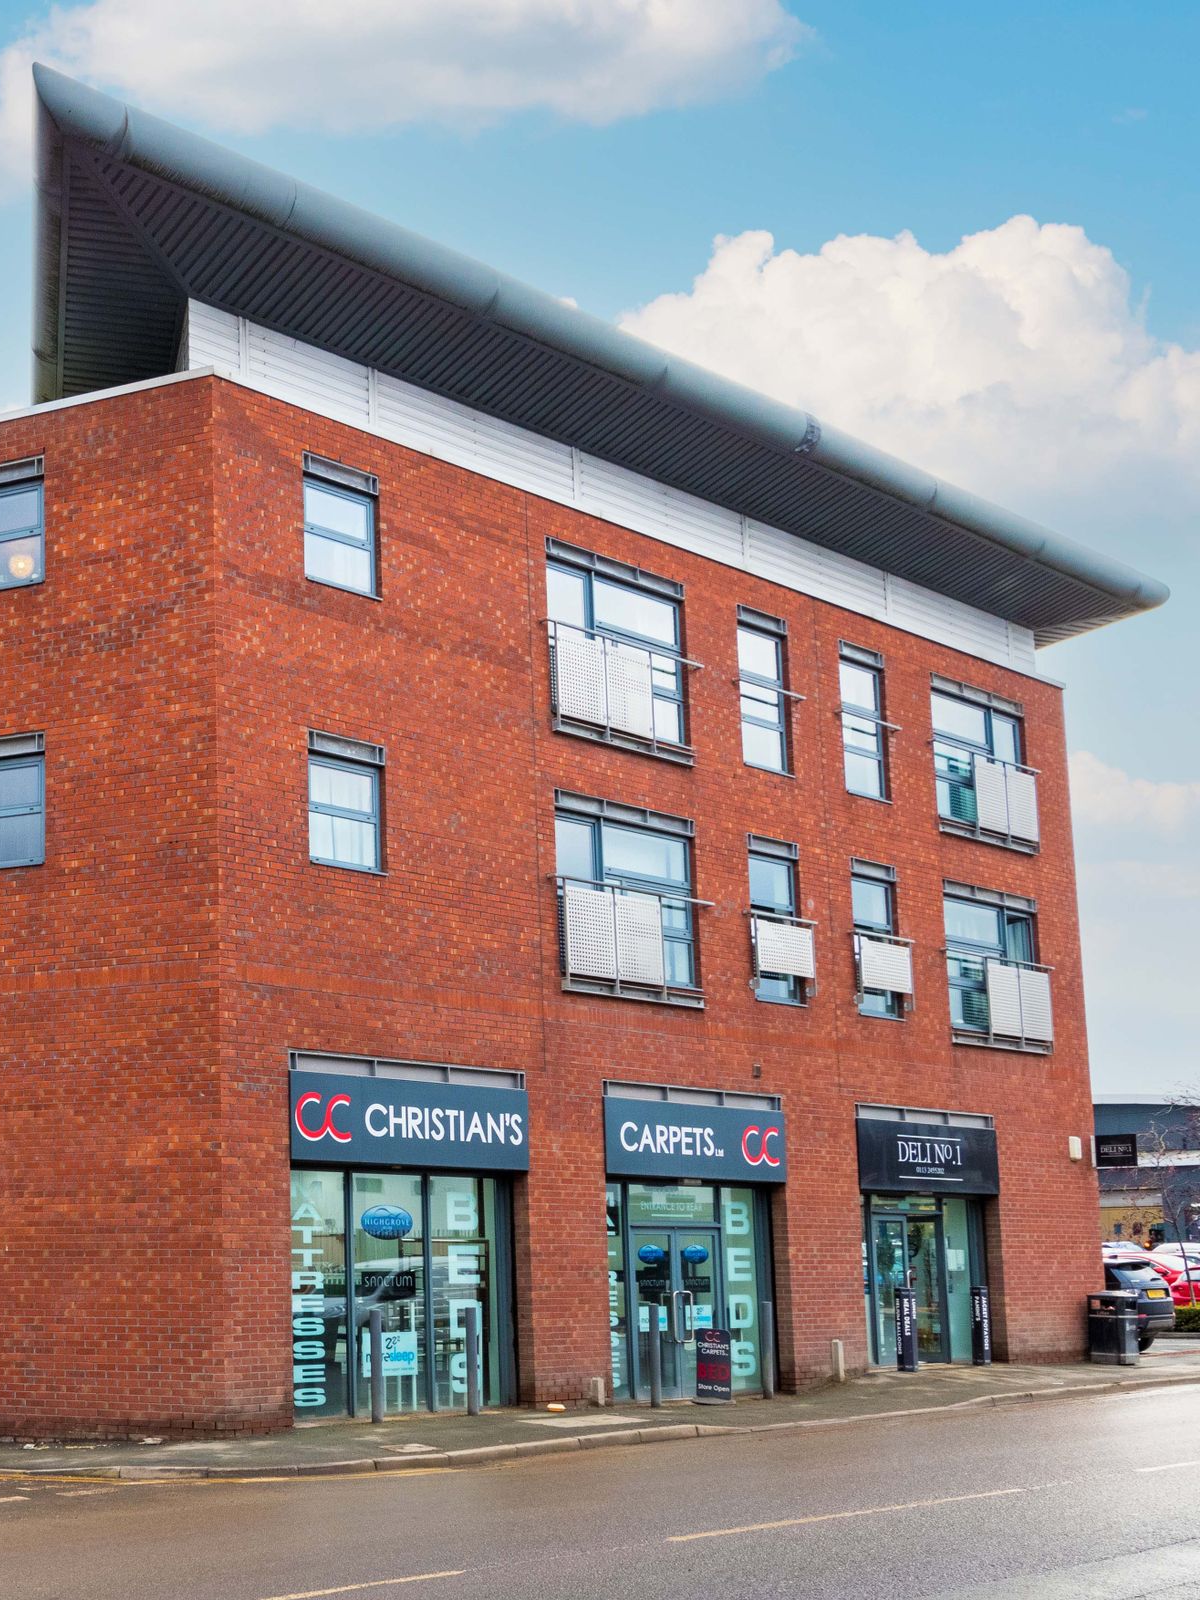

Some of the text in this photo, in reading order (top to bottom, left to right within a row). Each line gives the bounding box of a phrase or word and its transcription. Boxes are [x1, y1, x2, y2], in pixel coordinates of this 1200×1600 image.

[295, 1091, 523, 1146] CC CHRISTIAN'S
[620, 1121, 715, 1156] CARPETS
[742, 1125, 781, 1167] CC
[897, 1141, 932, 1163] DELI
[364, 1217, 410, 1226] HIGHGROVE
[291, 1179, 326, 1407] MATTRESSES
[364, 1275, 413, 1287] SANCTUM
[447, 1192, 483, 1394] BEDS
[725, 1202, 757, 1377] BEDS
[701, 1348, 725, 1356] CARPETS
[698, 1361, 730, 1380] BED
